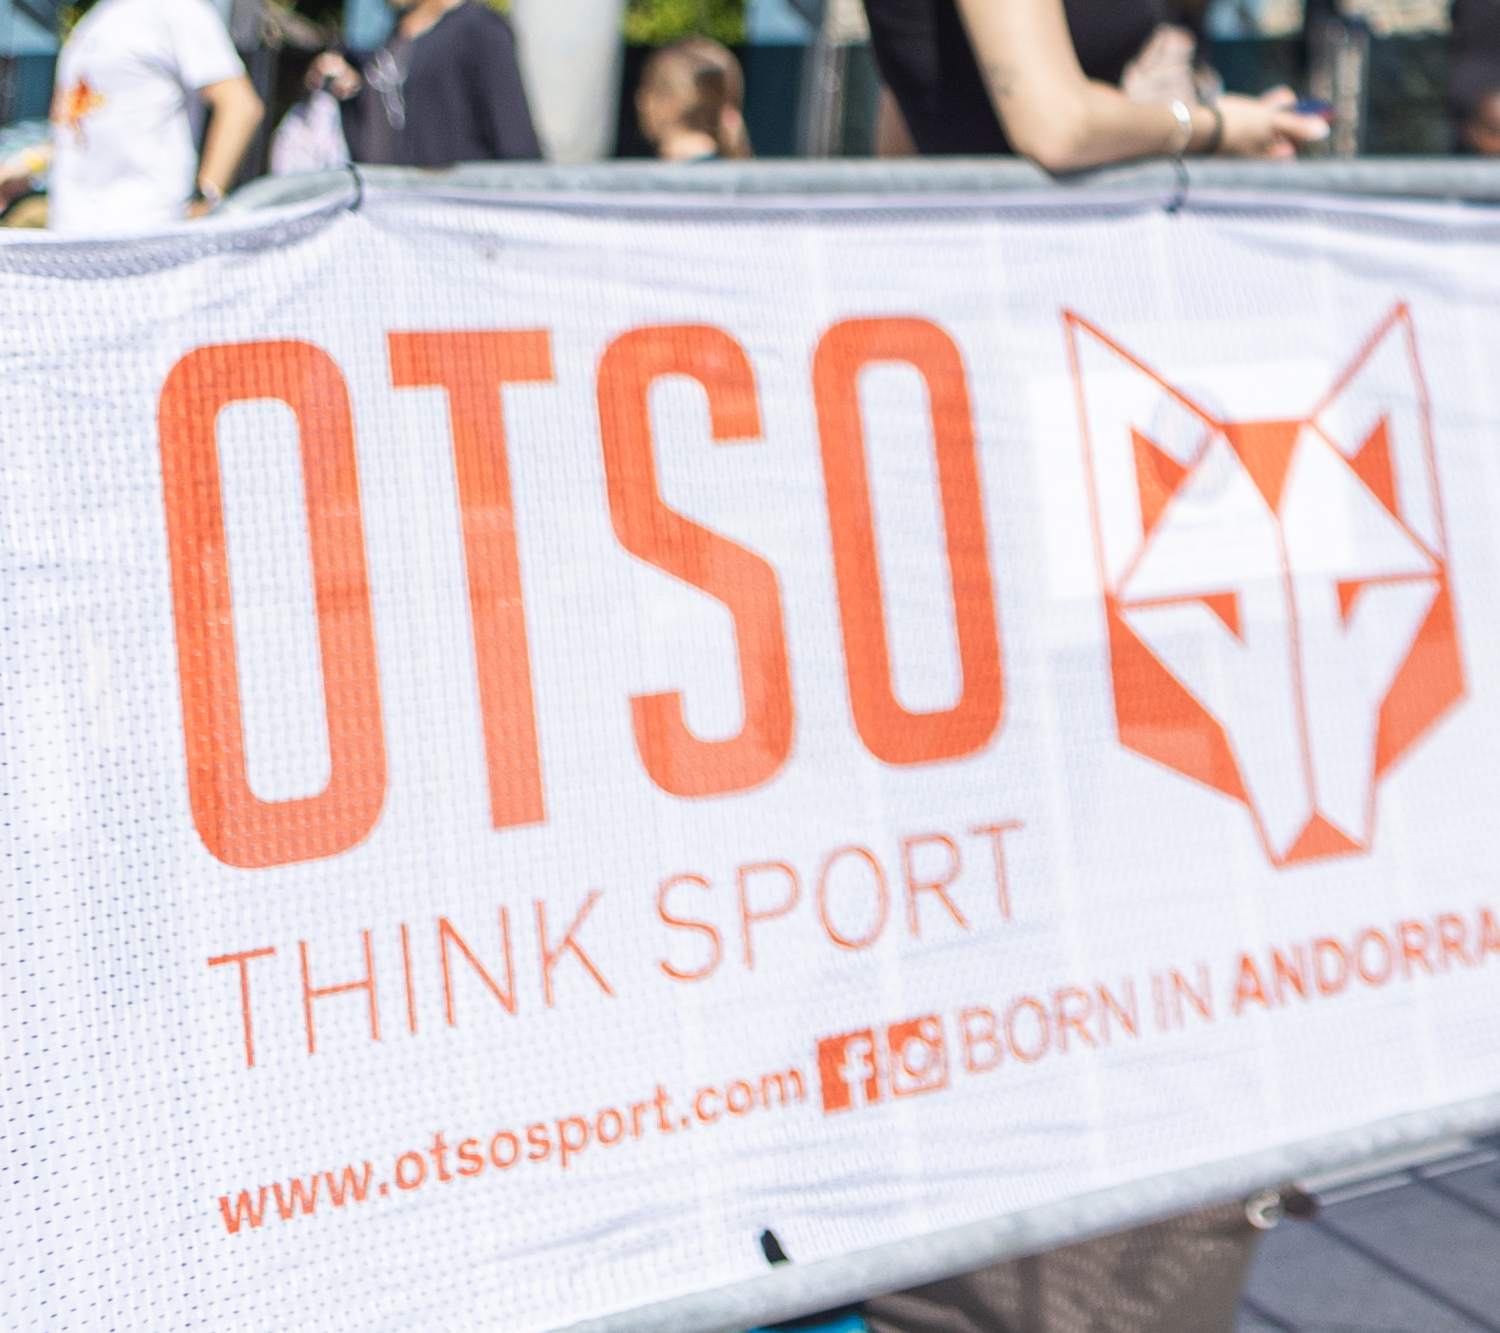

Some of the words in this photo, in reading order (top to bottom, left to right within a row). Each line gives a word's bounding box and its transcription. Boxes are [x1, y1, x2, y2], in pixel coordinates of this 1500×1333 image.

[156, 314, 1006, 870] OTSO
[207, 889, 615, 1070] THINK
[653, 821, 1030, 985] SPORT
[218, 1064, 806, 1234] www.otsosport.com
[957, 971, 1143, 1076] BORN
[1147, 963, 1213, 1029] IN
